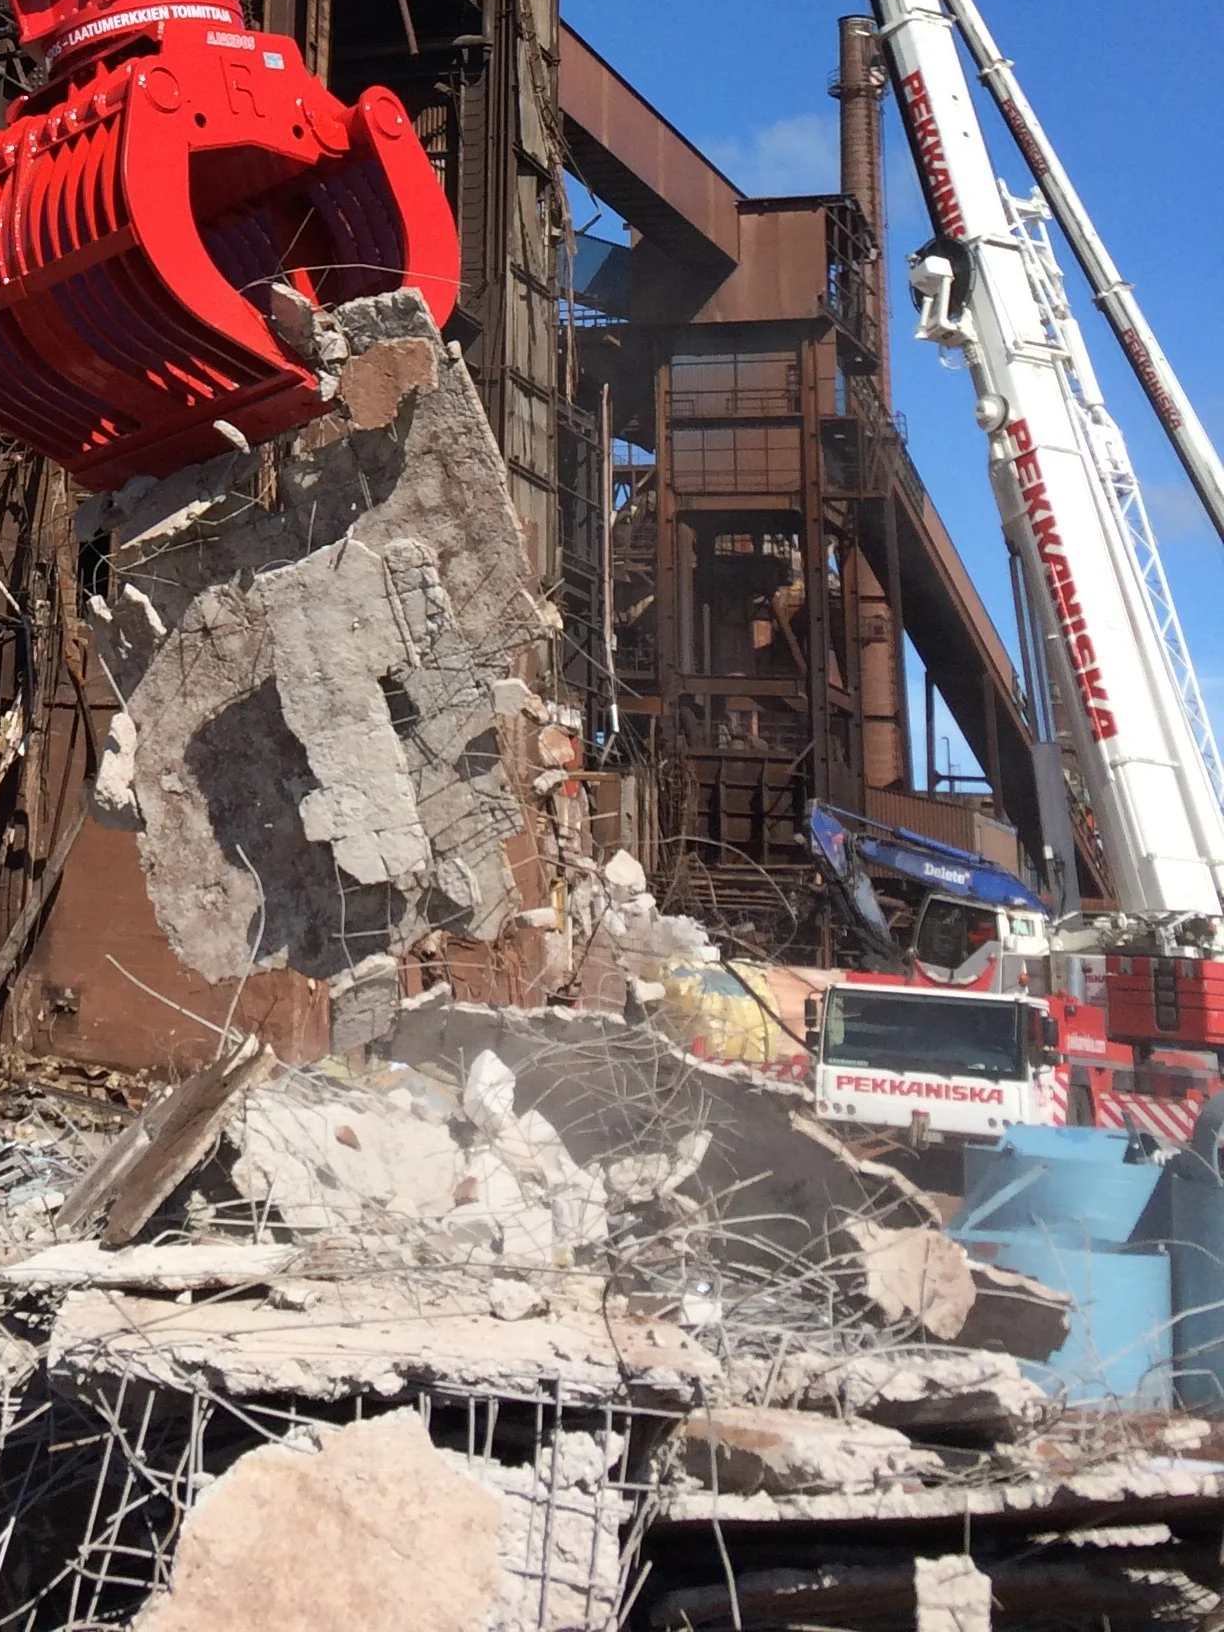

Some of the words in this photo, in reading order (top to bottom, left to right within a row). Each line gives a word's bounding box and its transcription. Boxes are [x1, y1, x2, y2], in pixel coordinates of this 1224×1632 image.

[68, 5, 170, 47] LAATUMERKKIEN
[1123, 328, 1181, 429] PEKKANISKA
[1007, 418, 1119, 743] PEKKANISKA
[924, 862, 966, 885] Delete
[836, 1074, 1005, 1106] PEKKANISKA
